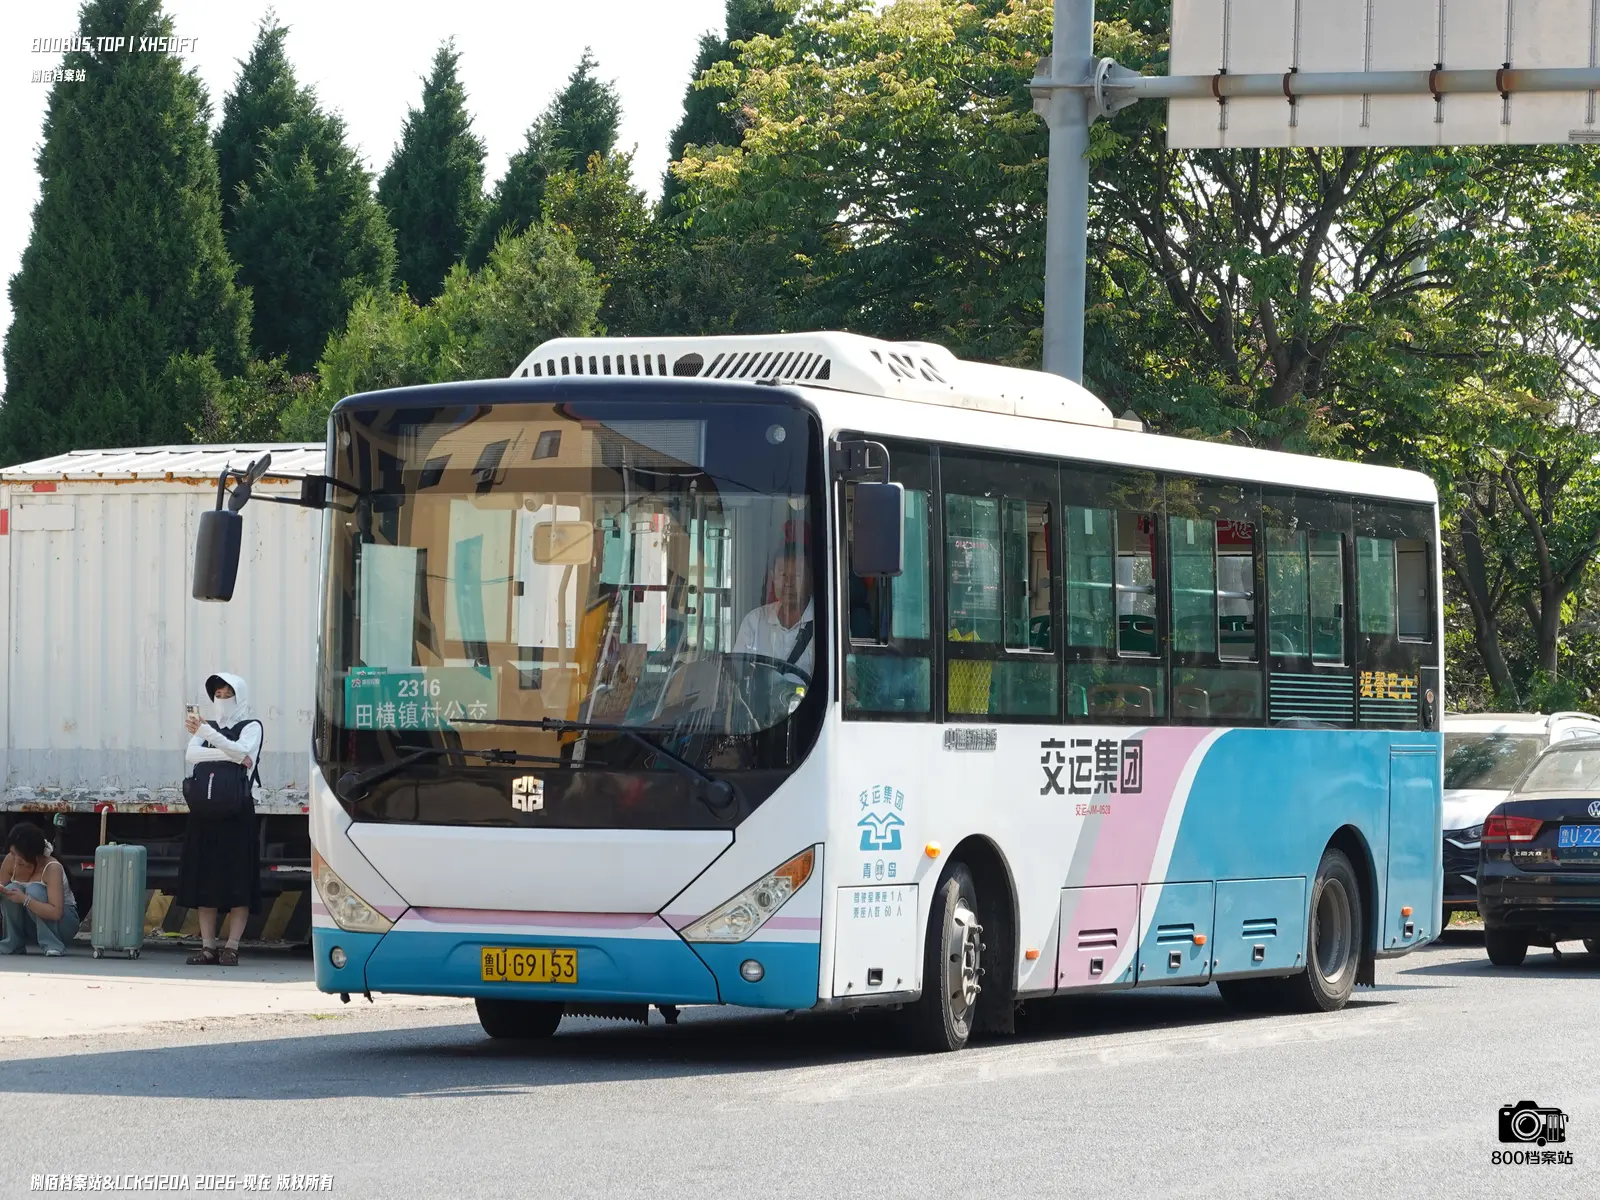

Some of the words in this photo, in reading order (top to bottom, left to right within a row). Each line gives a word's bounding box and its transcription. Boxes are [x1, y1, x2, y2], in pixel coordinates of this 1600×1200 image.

[397, 678, 441, 697] 2316
[355, 699, 487, 728] 田横镇村公交
[1040, 738, 1143, 795] 交运集团
[859, 785, 904, 811] 交运集团
